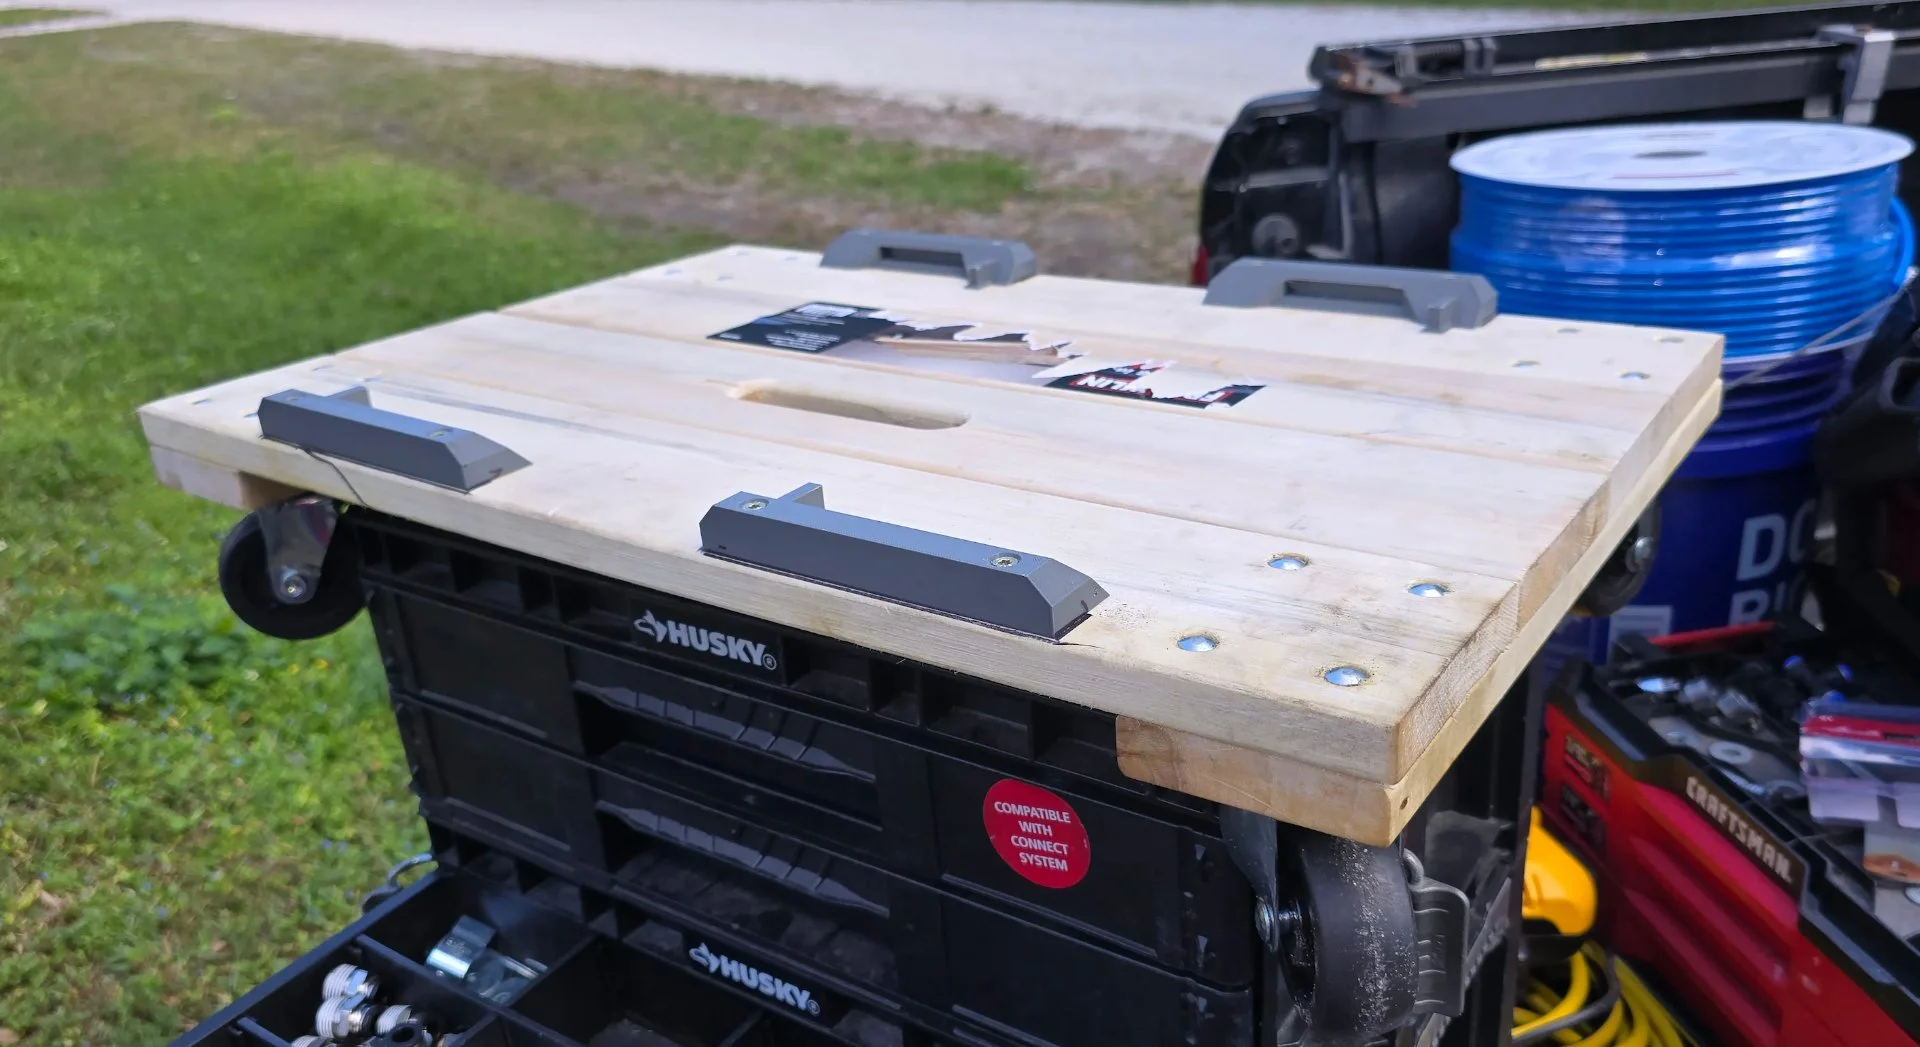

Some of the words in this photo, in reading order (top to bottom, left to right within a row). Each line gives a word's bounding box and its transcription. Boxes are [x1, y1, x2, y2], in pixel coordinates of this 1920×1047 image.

[994, 801, 1071, 823] COMPATIBLE
[1018, 820, 1053, 836] WITH
[1686, 776, 1792, 883] CRAFTSMAN
[1011, 835, 1068, 855] CONNECT
[1019, 852, 1068, 872] SYSTEM
